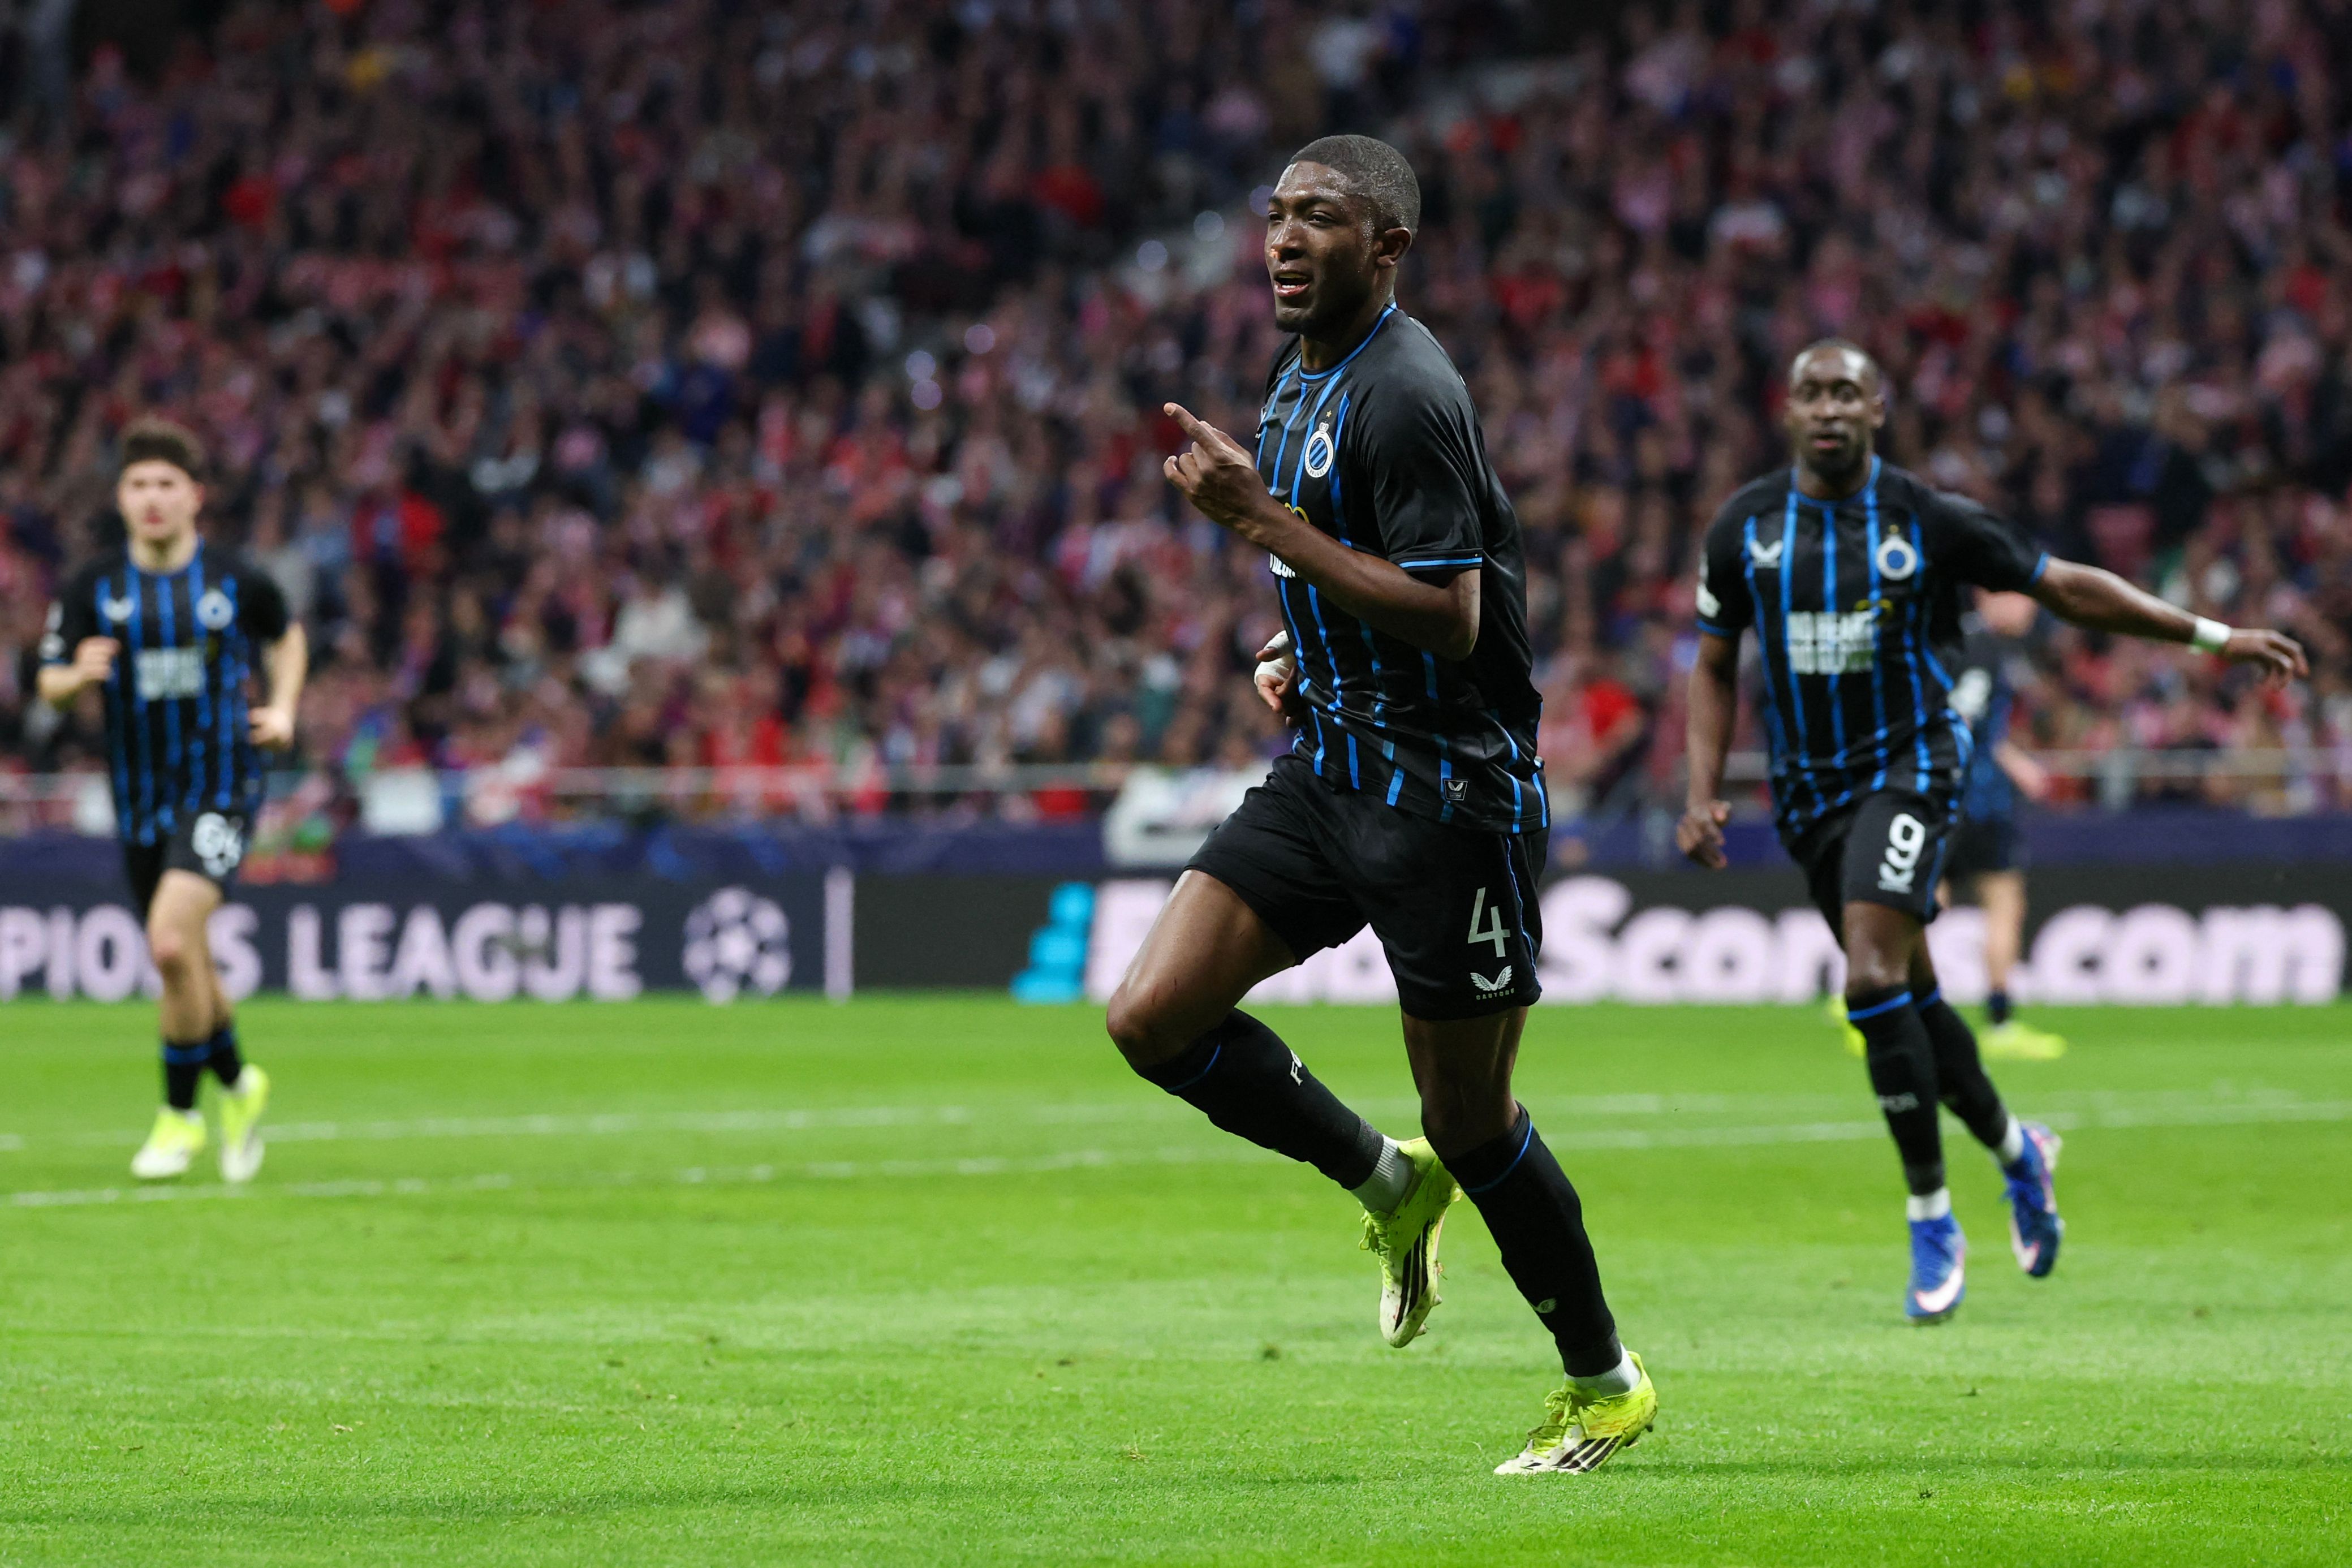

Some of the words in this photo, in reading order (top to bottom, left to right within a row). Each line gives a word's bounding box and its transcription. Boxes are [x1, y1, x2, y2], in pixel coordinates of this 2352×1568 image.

[1885, 813, 1925, 871] 9
[0, 904, 261, 1001] PIOS
[286, 903, 643, 1002] LEAGUE
[1468, 887, 1510, 957] 4
